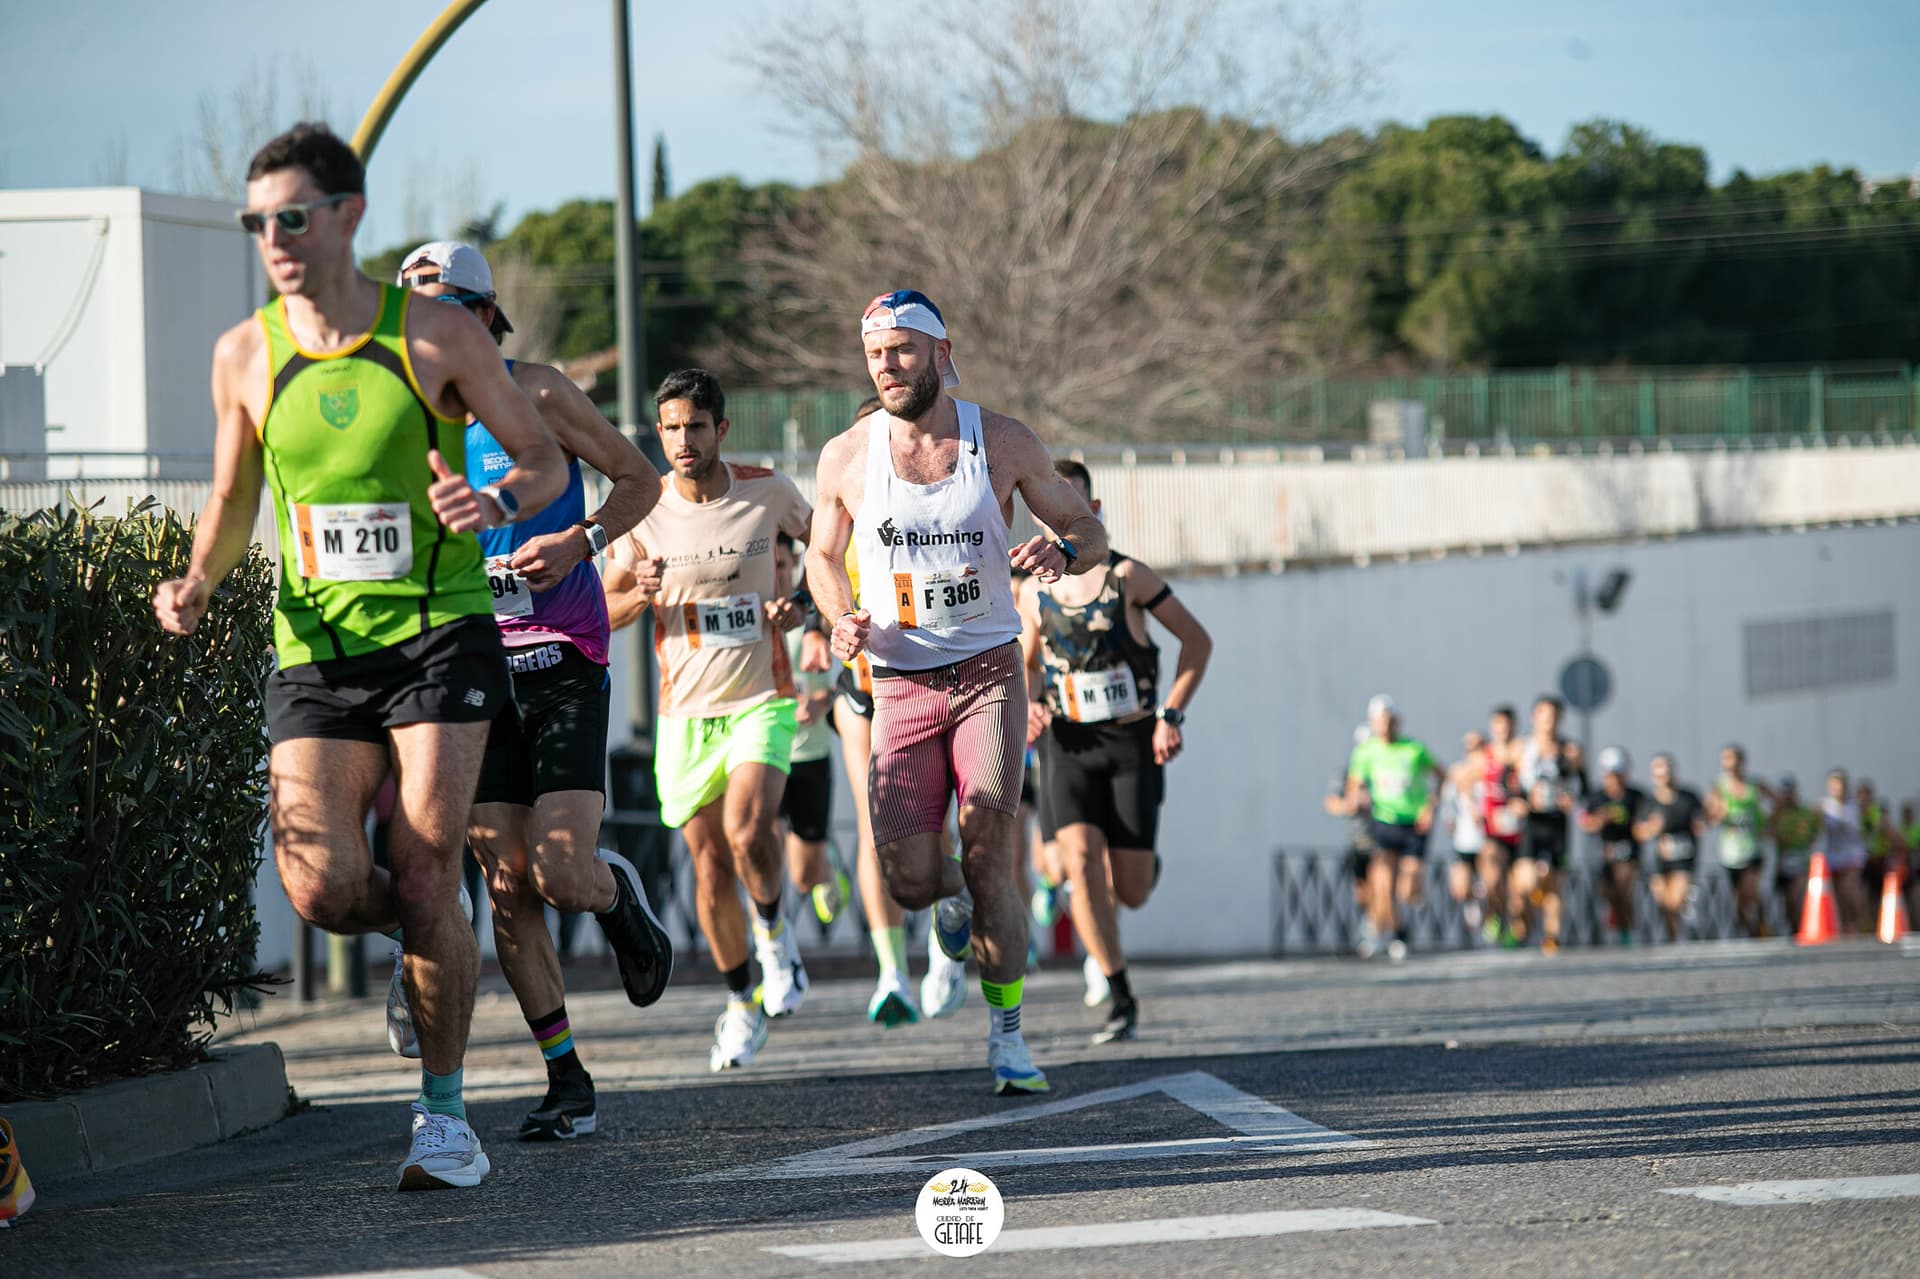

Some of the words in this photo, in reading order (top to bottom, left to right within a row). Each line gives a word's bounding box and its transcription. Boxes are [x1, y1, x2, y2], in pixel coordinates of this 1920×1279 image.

[324, 529, 342, 554] M
[355, 526, 400, 553] 210
[745, 538, 770, 553] 2022
[907, 530, 984, 546] Running
[489, 572, 519, 598] 94
[924, 588, 934, 610] F
[943, 578, 981, 608] 386
[901, 592, 911, 607] A
[705, 614, 720, 632] M
[726, 607, 756, 630] 184
[1083, 688, 1097, 704] M
[1103, 682, 1128, 703] 176
